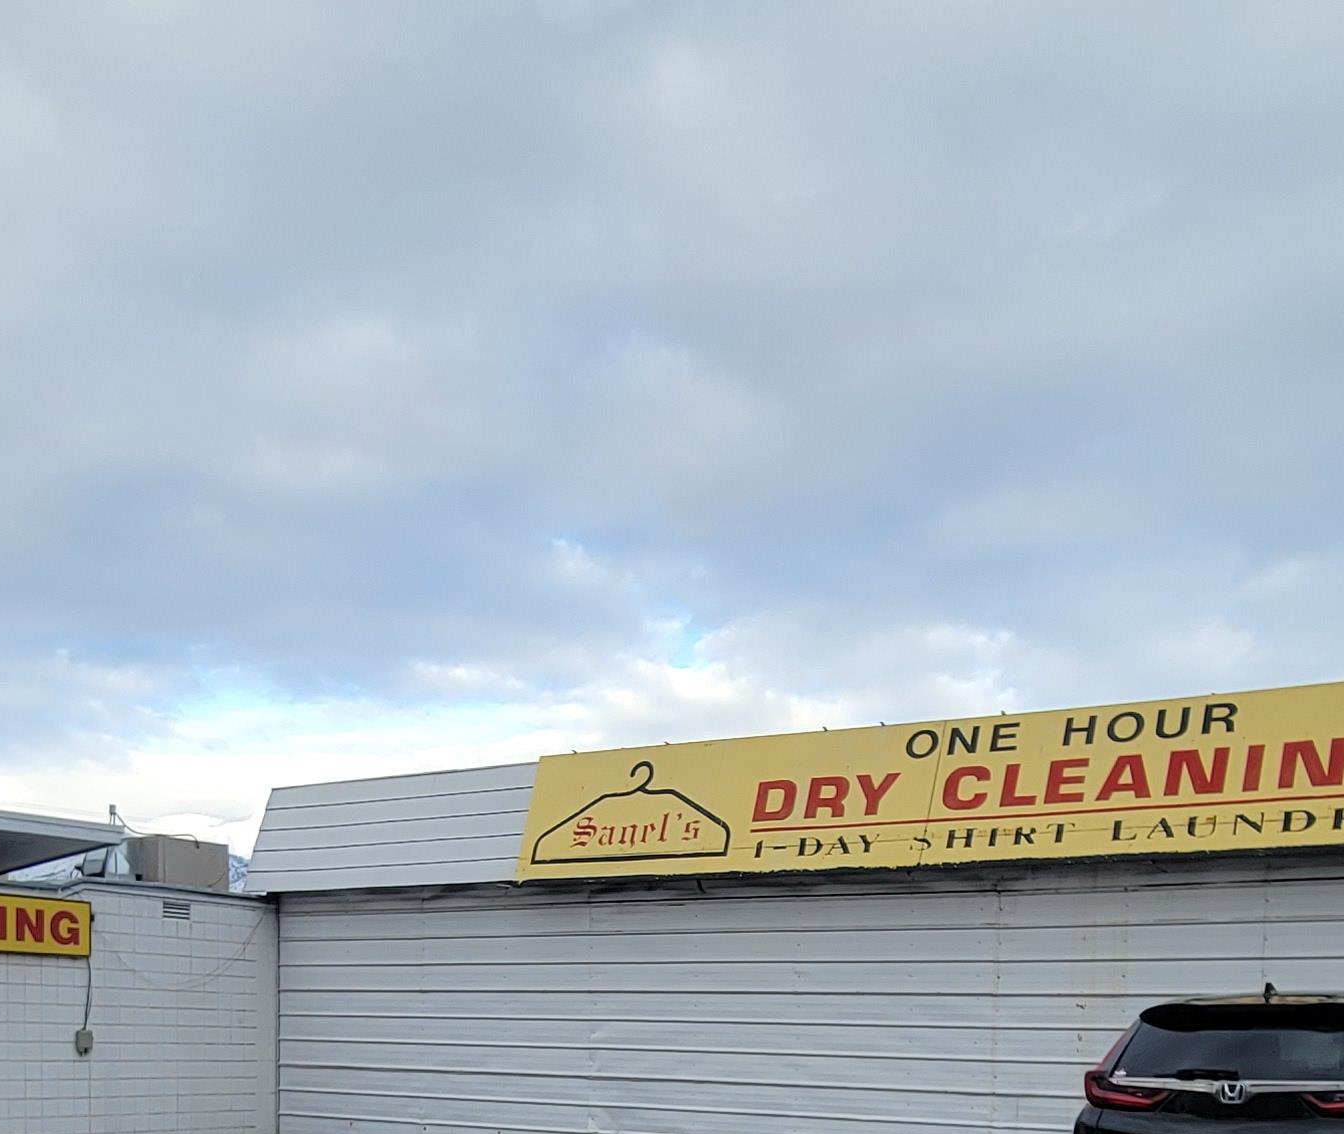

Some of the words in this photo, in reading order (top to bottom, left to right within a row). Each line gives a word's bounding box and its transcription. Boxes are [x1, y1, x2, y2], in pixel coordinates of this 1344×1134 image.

[905, 721, 1021, 760] ONE
[1061, 702, 1239, 747] HOUR
[751, 771, 902, 822] DRY
[910, 822, 1076, 851] SHIRT
